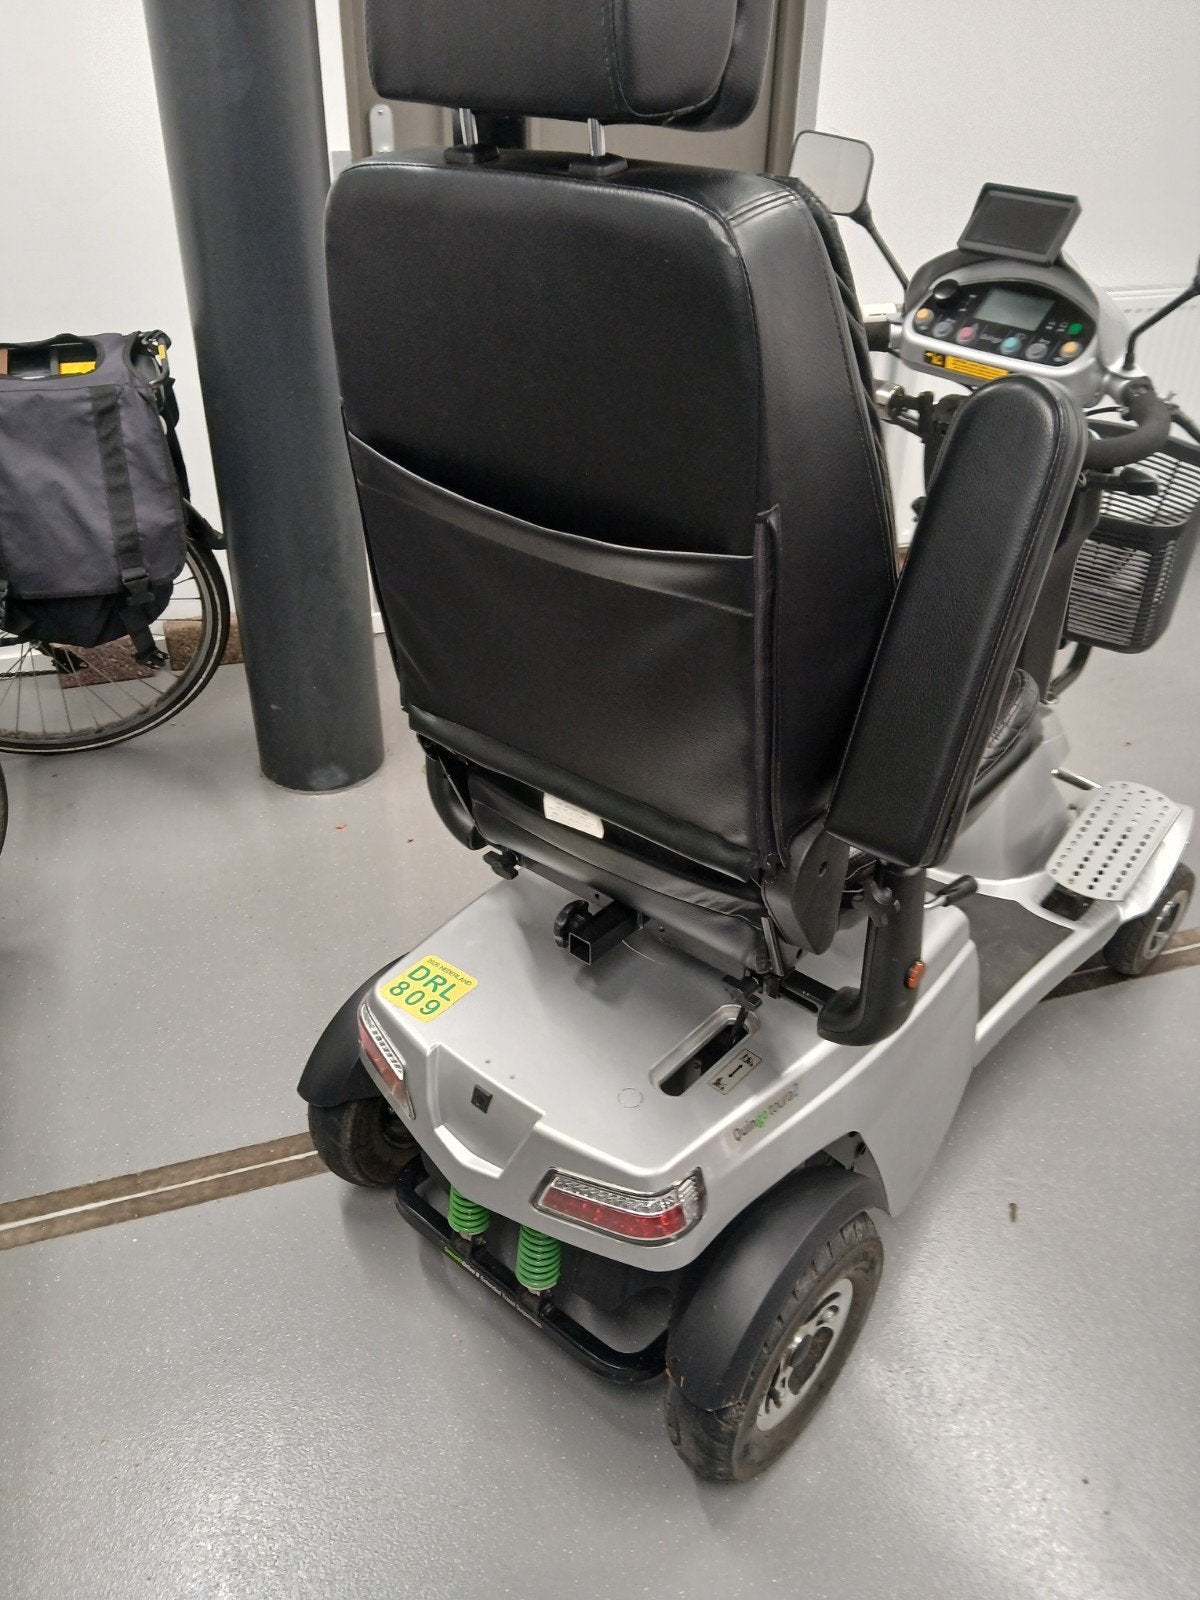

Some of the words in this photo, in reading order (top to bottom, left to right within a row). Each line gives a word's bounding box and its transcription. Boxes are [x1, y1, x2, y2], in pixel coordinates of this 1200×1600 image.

[407, 964, 457, 1002] DRL
[439, 965, 472, 986] NEDERLAND
[389, 980, 441, 1015] 809
